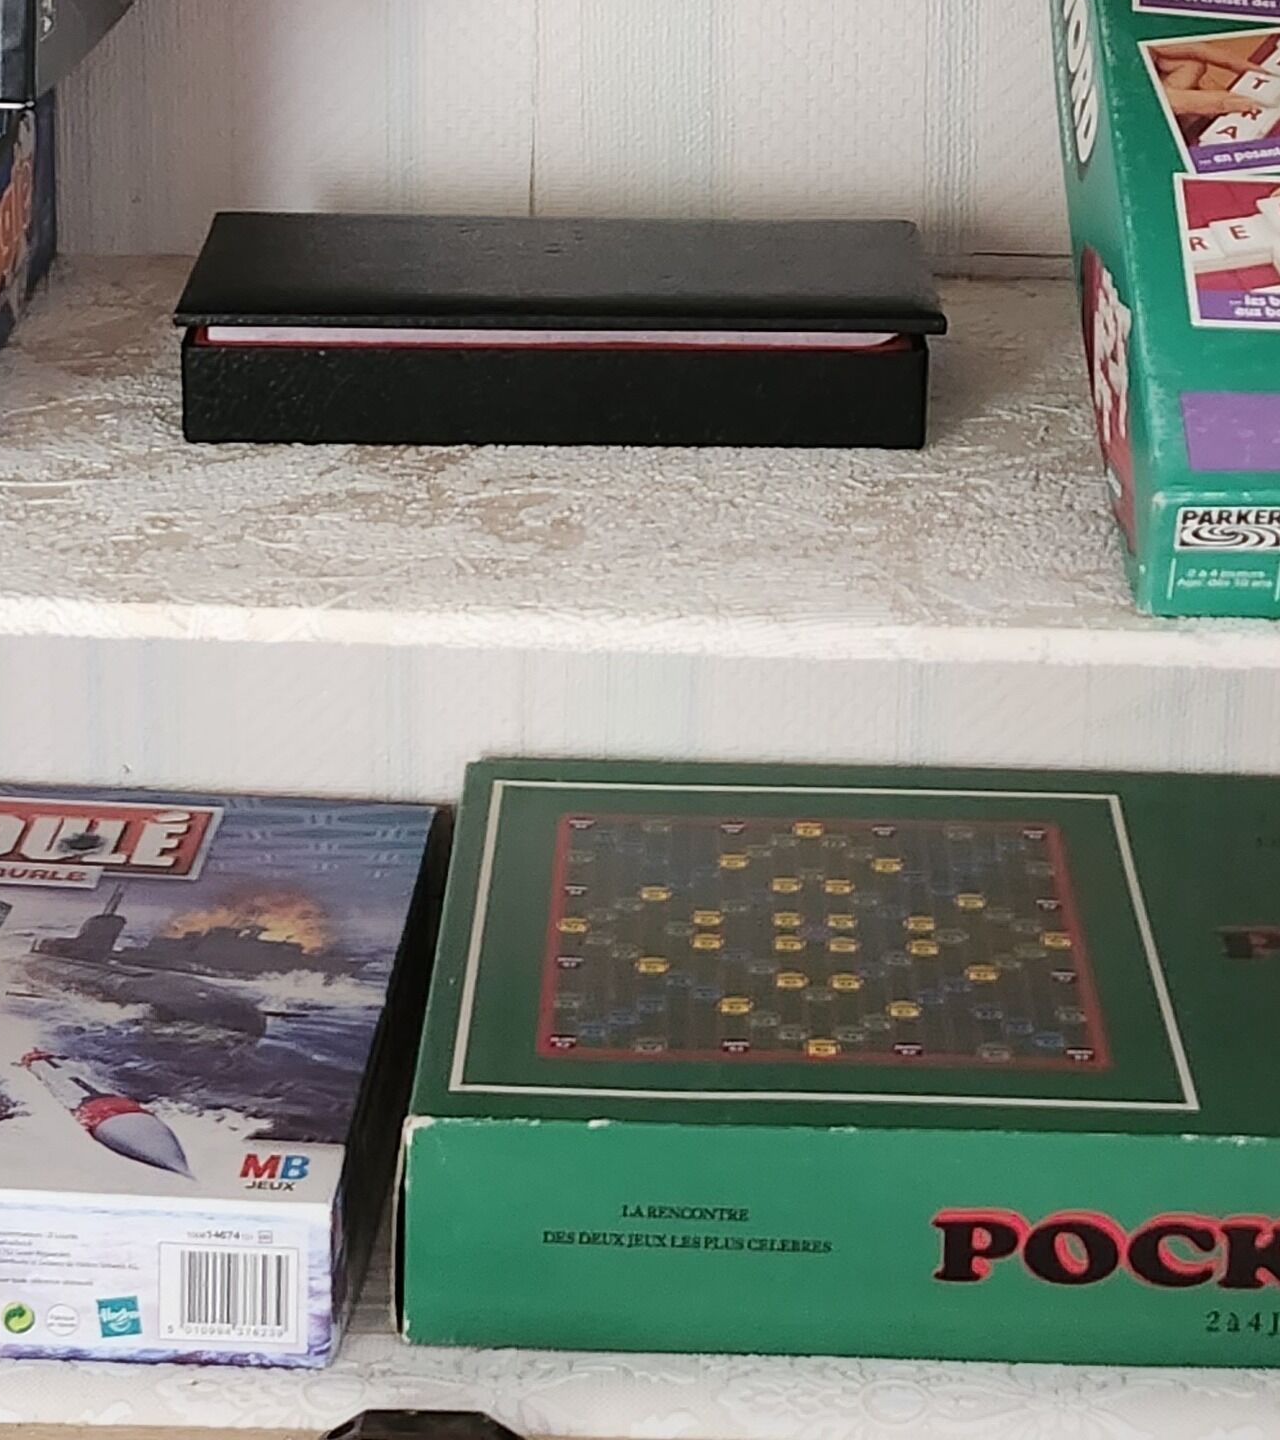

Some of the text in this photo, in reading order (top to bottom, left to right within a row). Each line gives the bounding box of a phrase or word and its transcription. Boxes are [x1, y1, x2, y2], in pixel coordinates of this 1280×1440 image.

[1213, 150, 1232, 163] en
[1243, 294, 1268, 307] les
[239, 1153, 311, 1180] MB
[244, 1181, 297, 1192] JEUX
[621, 1203, 750, 1223] LA RENCONTRE
[542, 1230, 745, 1251] DES DEUX JEUX LES PLUS
[1205, 1311, 1221, 1333] 2
[1226, 1310, 1241, 1334] à
[1246, 1312, 1263, 1334] 4
